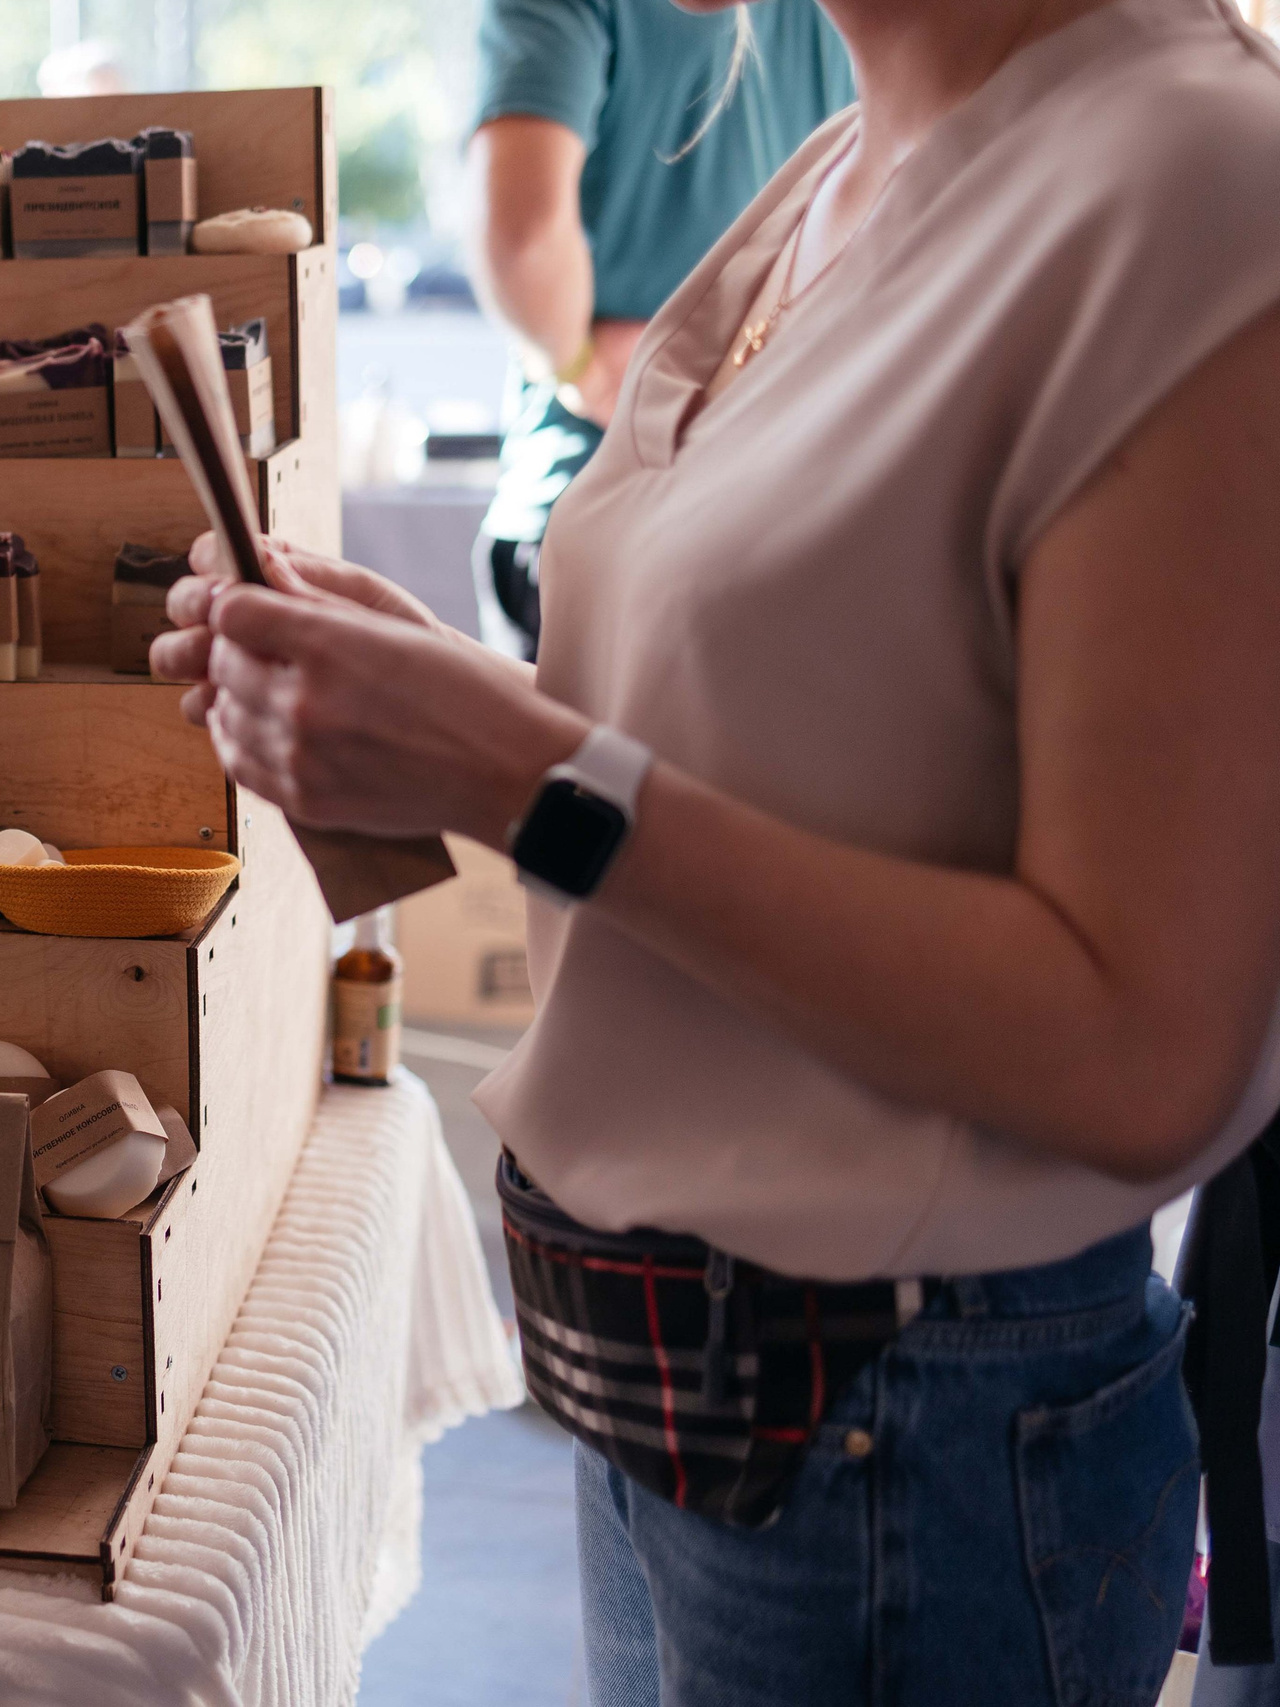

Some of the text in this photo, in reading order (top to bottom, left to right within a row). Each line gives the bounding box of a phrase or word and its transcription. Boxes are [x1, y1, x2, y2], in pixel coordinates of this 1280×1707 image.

[32, 1126, 77, 1159] ЙСТВЕННОЕ
[76, 1101, 122, 1132] КОКОСОВОЕ
[59, 1103, 86, 1123] ОЛИВКА
